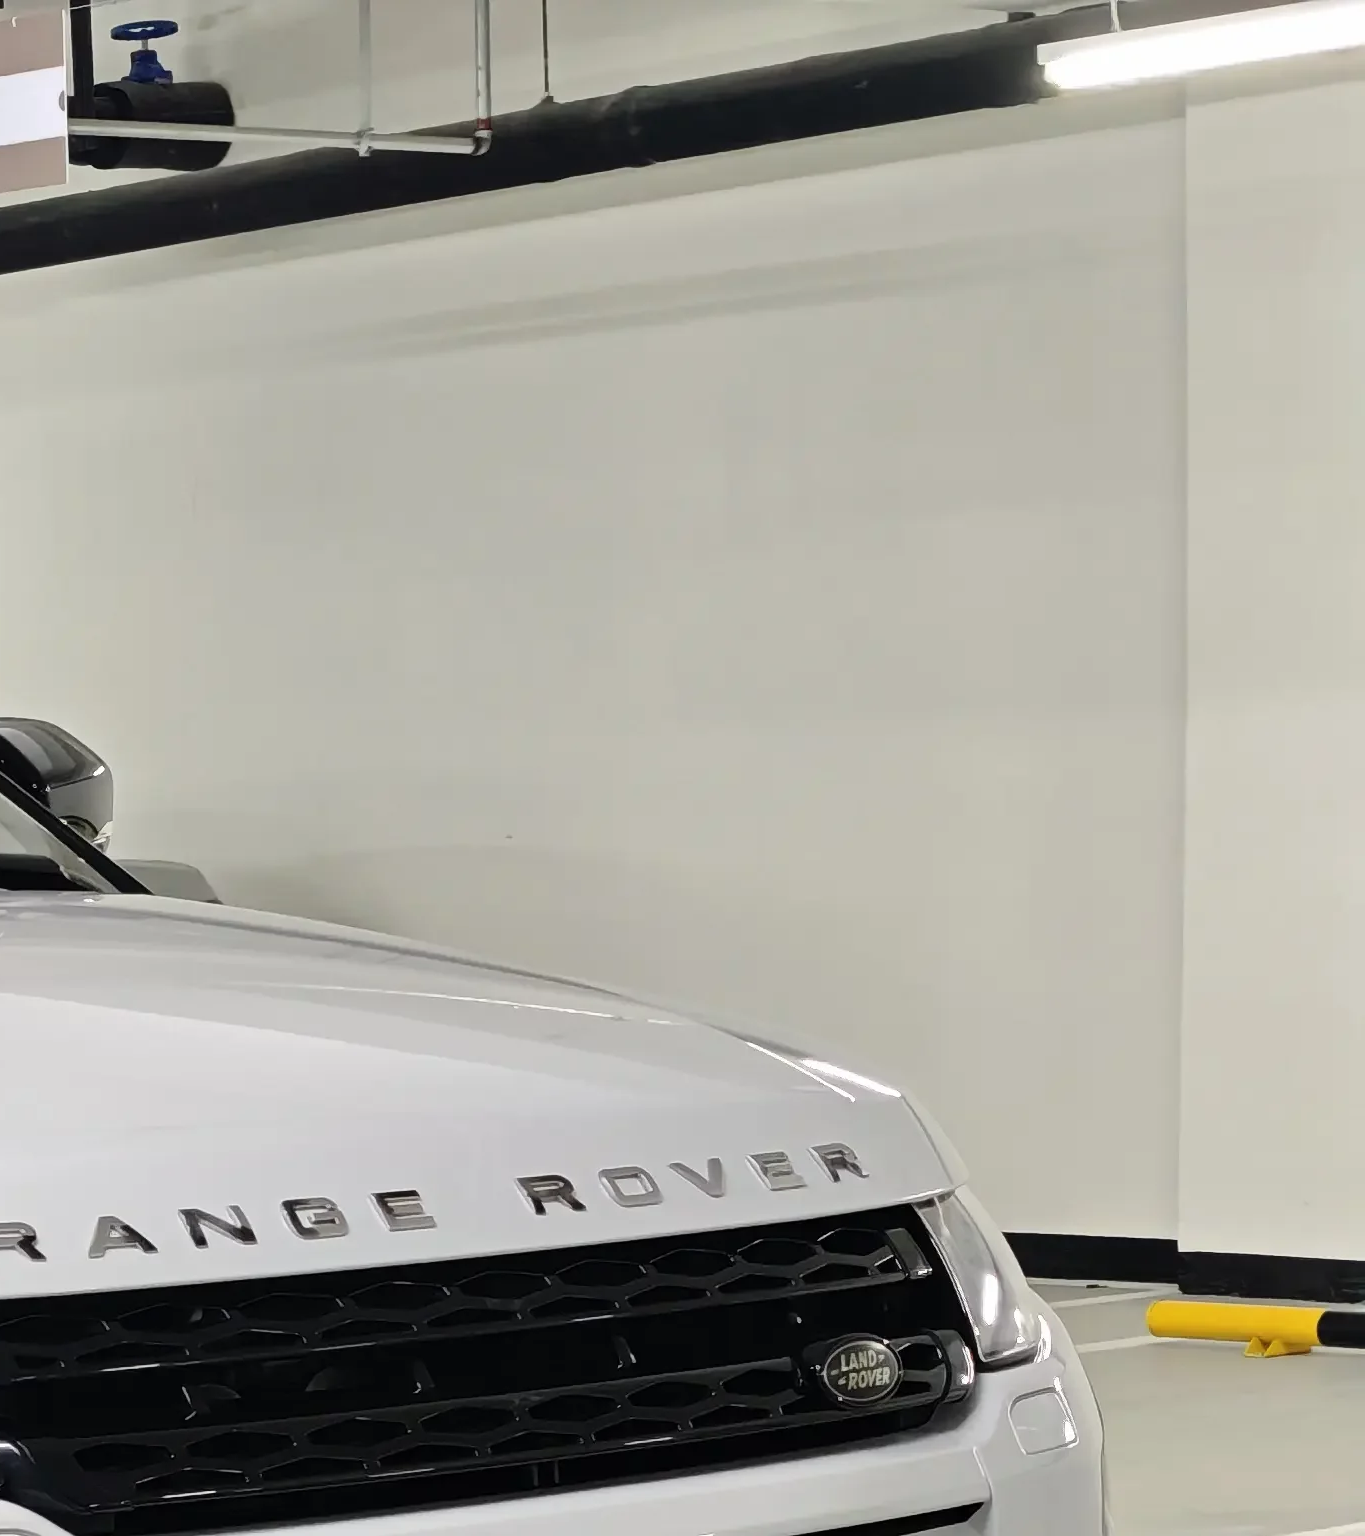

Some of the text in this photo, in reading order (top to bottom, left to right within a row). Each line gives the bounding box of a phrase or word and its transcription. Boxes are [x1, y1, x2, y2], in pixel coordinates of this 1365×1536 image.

[514, 1142, 869, 1216] ROVER
[840, 1350, 877, 1372] LAND
[848, 1366, 891, 1390] ROVER
